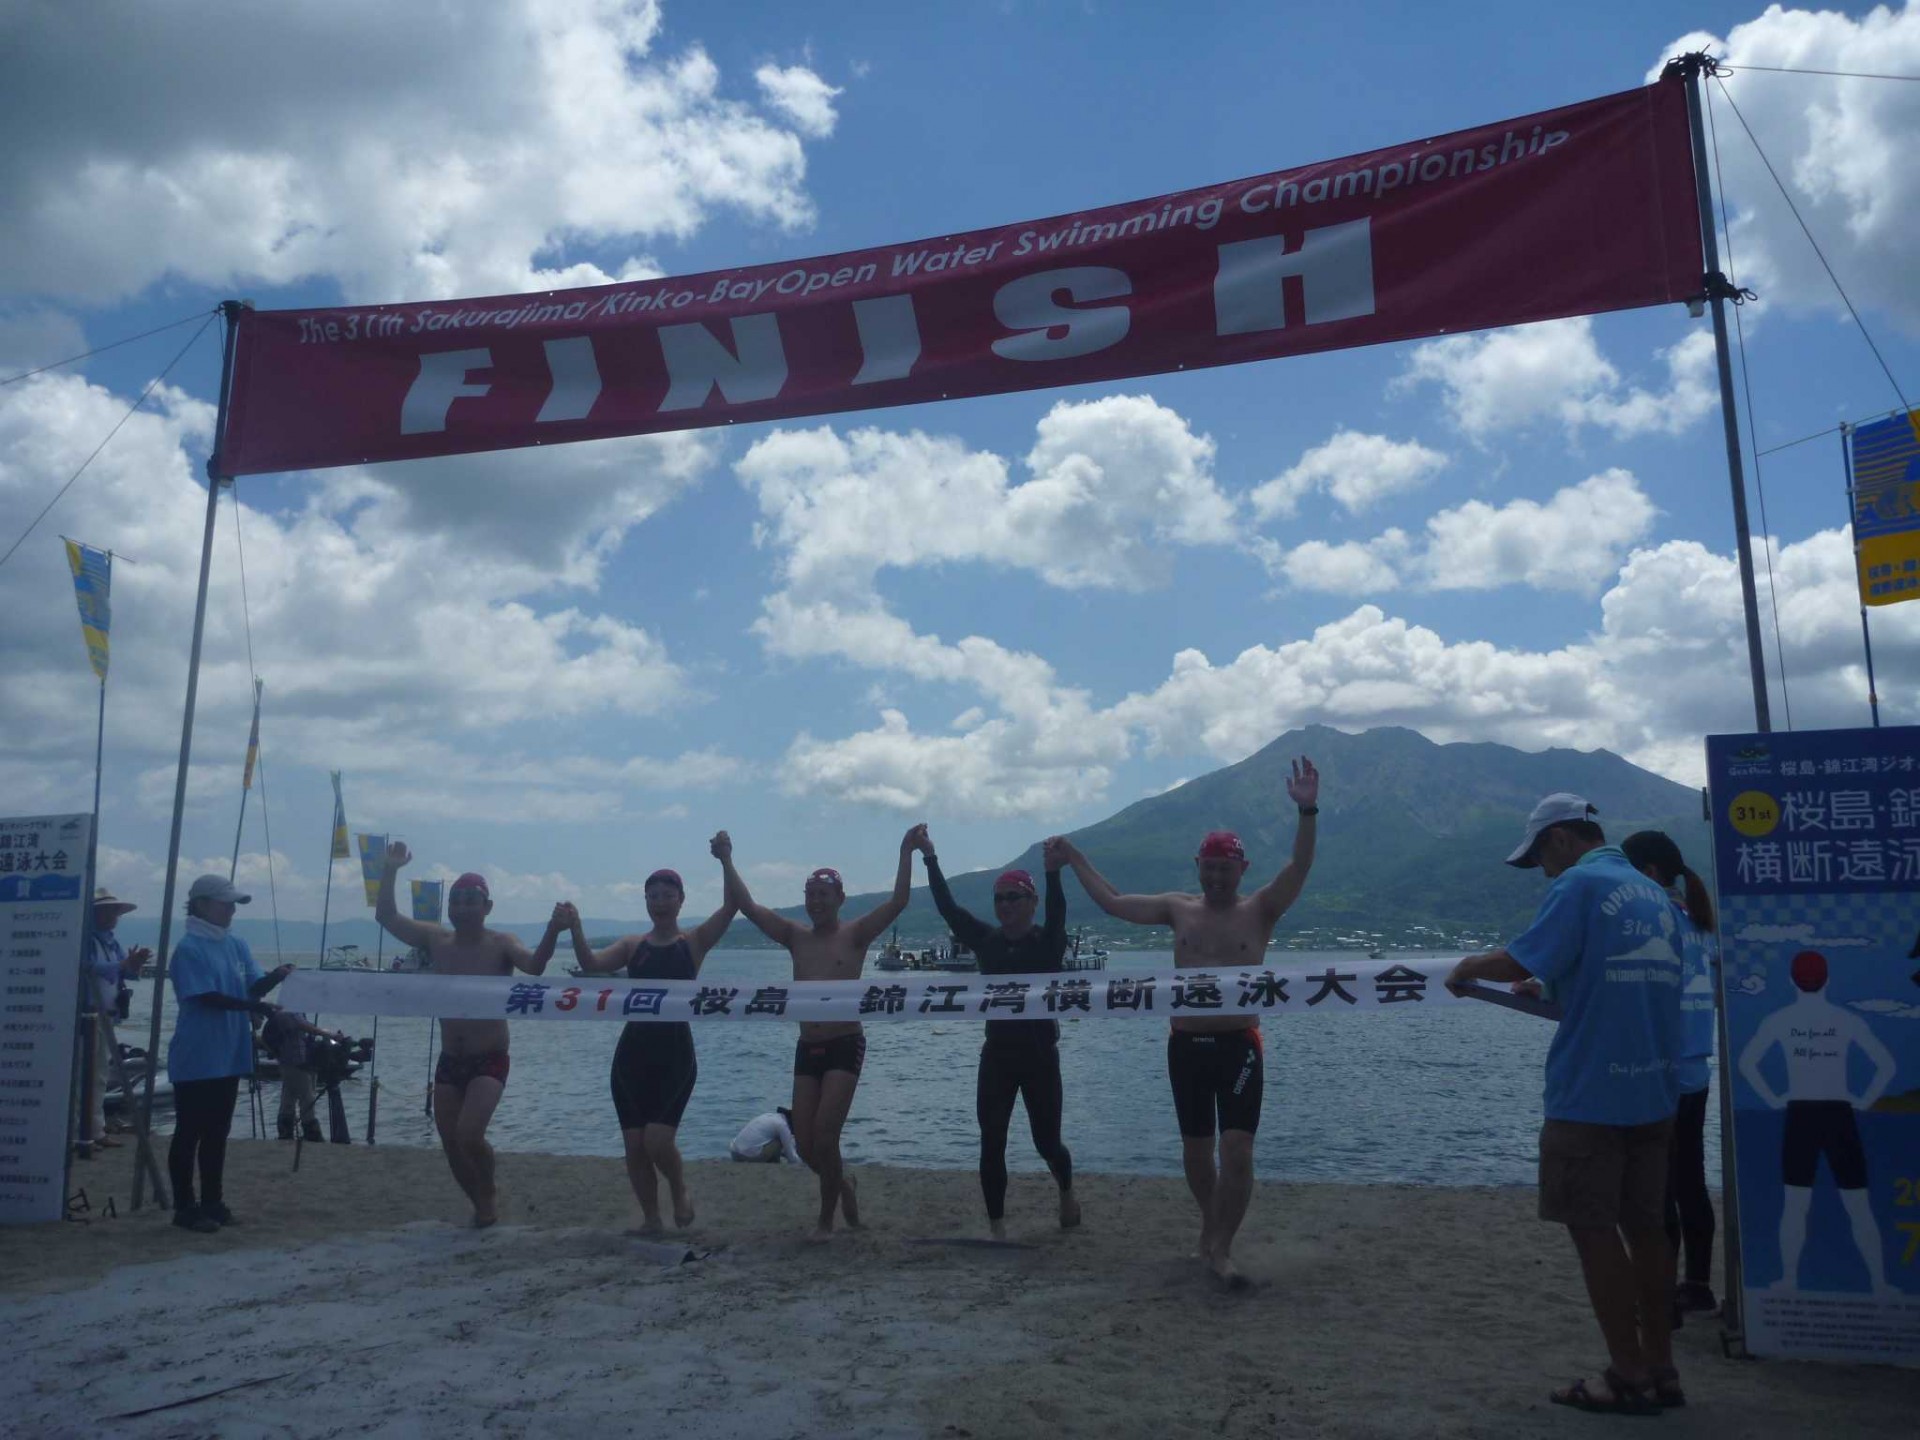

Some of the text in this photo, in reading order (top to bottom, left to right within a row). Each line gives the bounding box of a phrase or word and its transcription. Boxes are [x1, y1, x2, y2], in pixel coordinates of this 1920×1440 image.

[299, 317, 340, 343] The
[892, 240, 1004, 277] Water
[1012, 197, 1224, 256] Swimming
[1240, 125, 1570, 213] Championship
[400, 215, 1378, 436] FINISH
[1736, 806, 1771, 821] 31st
[1780, 755, 1920, 776] 桜島・錦江湾ジオ
